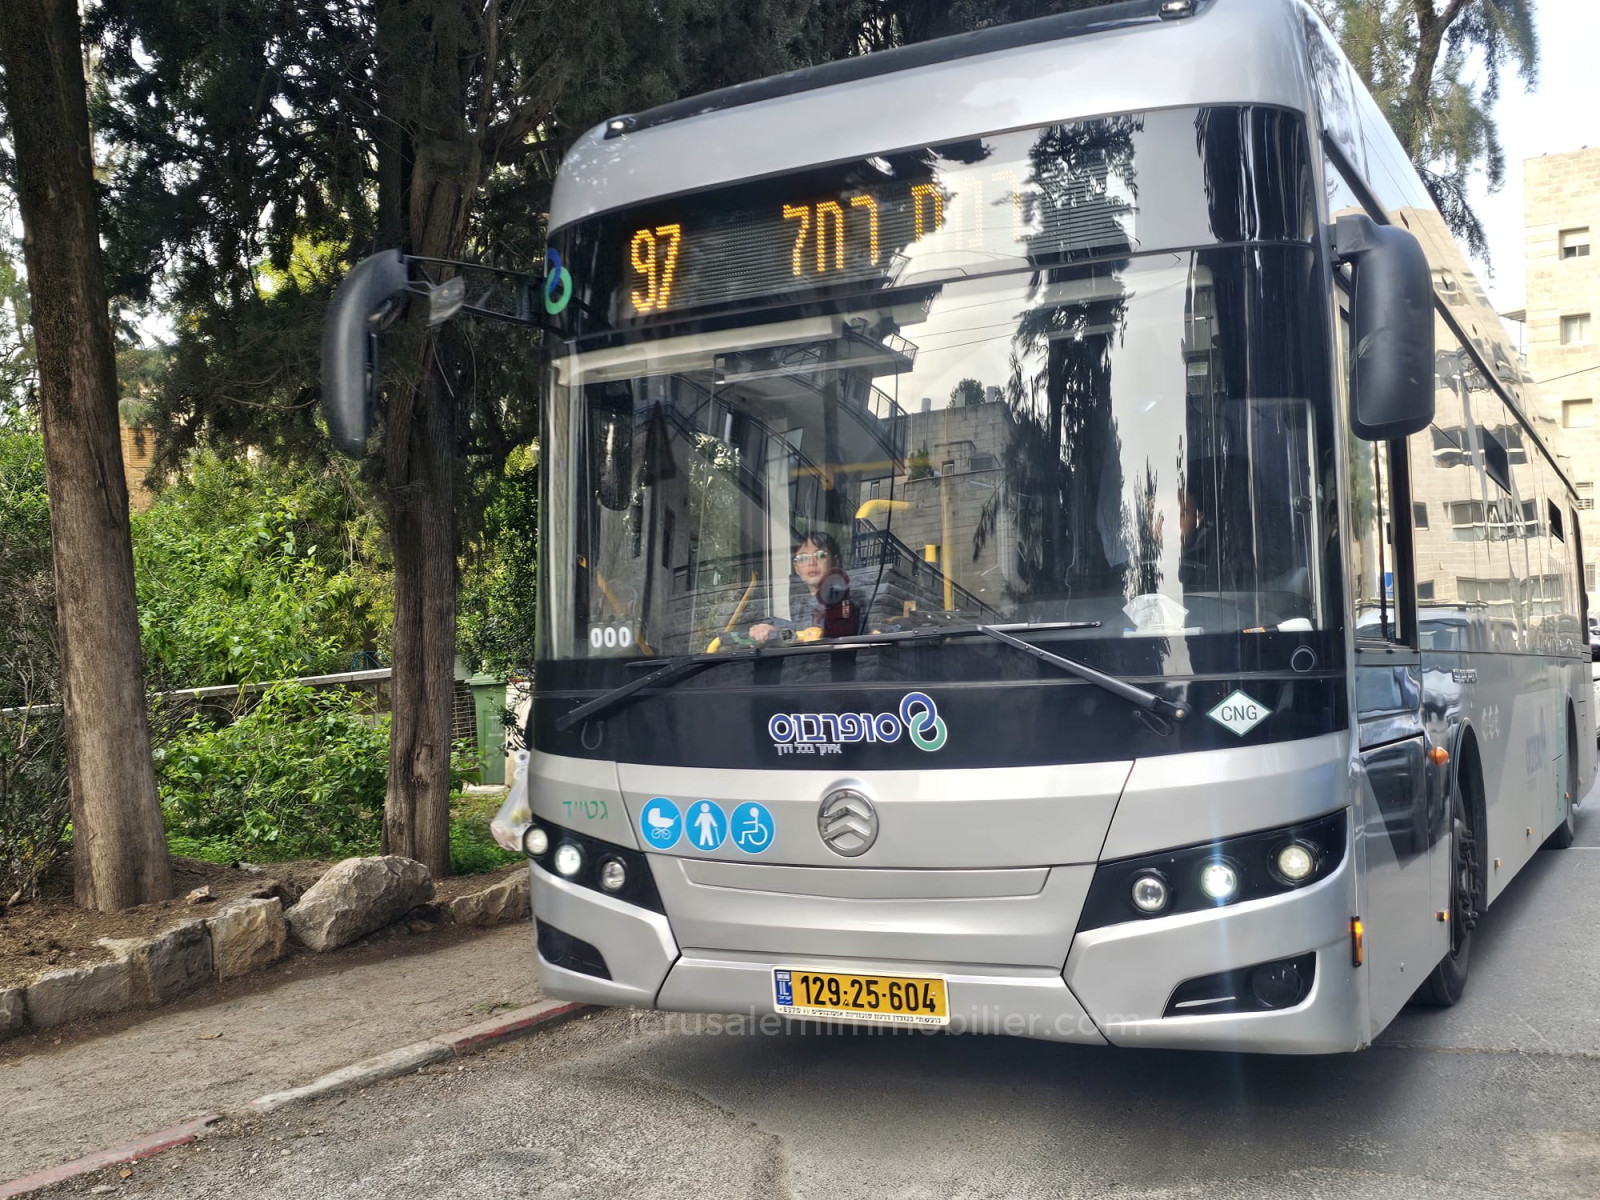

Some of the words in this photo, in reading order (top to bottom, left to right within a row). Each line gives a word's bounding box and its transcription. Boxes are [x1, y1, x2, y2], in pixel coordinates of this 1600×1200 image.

[783, 194, 878, 276] רחל
[631, 223, 680, 311] 97
[589, 626, 631, 648] 000
[1221, 704, 1258, 722] CNG
[768, 712, 902, 743] סופרבוס
[778, 981, 790, 995] IL
